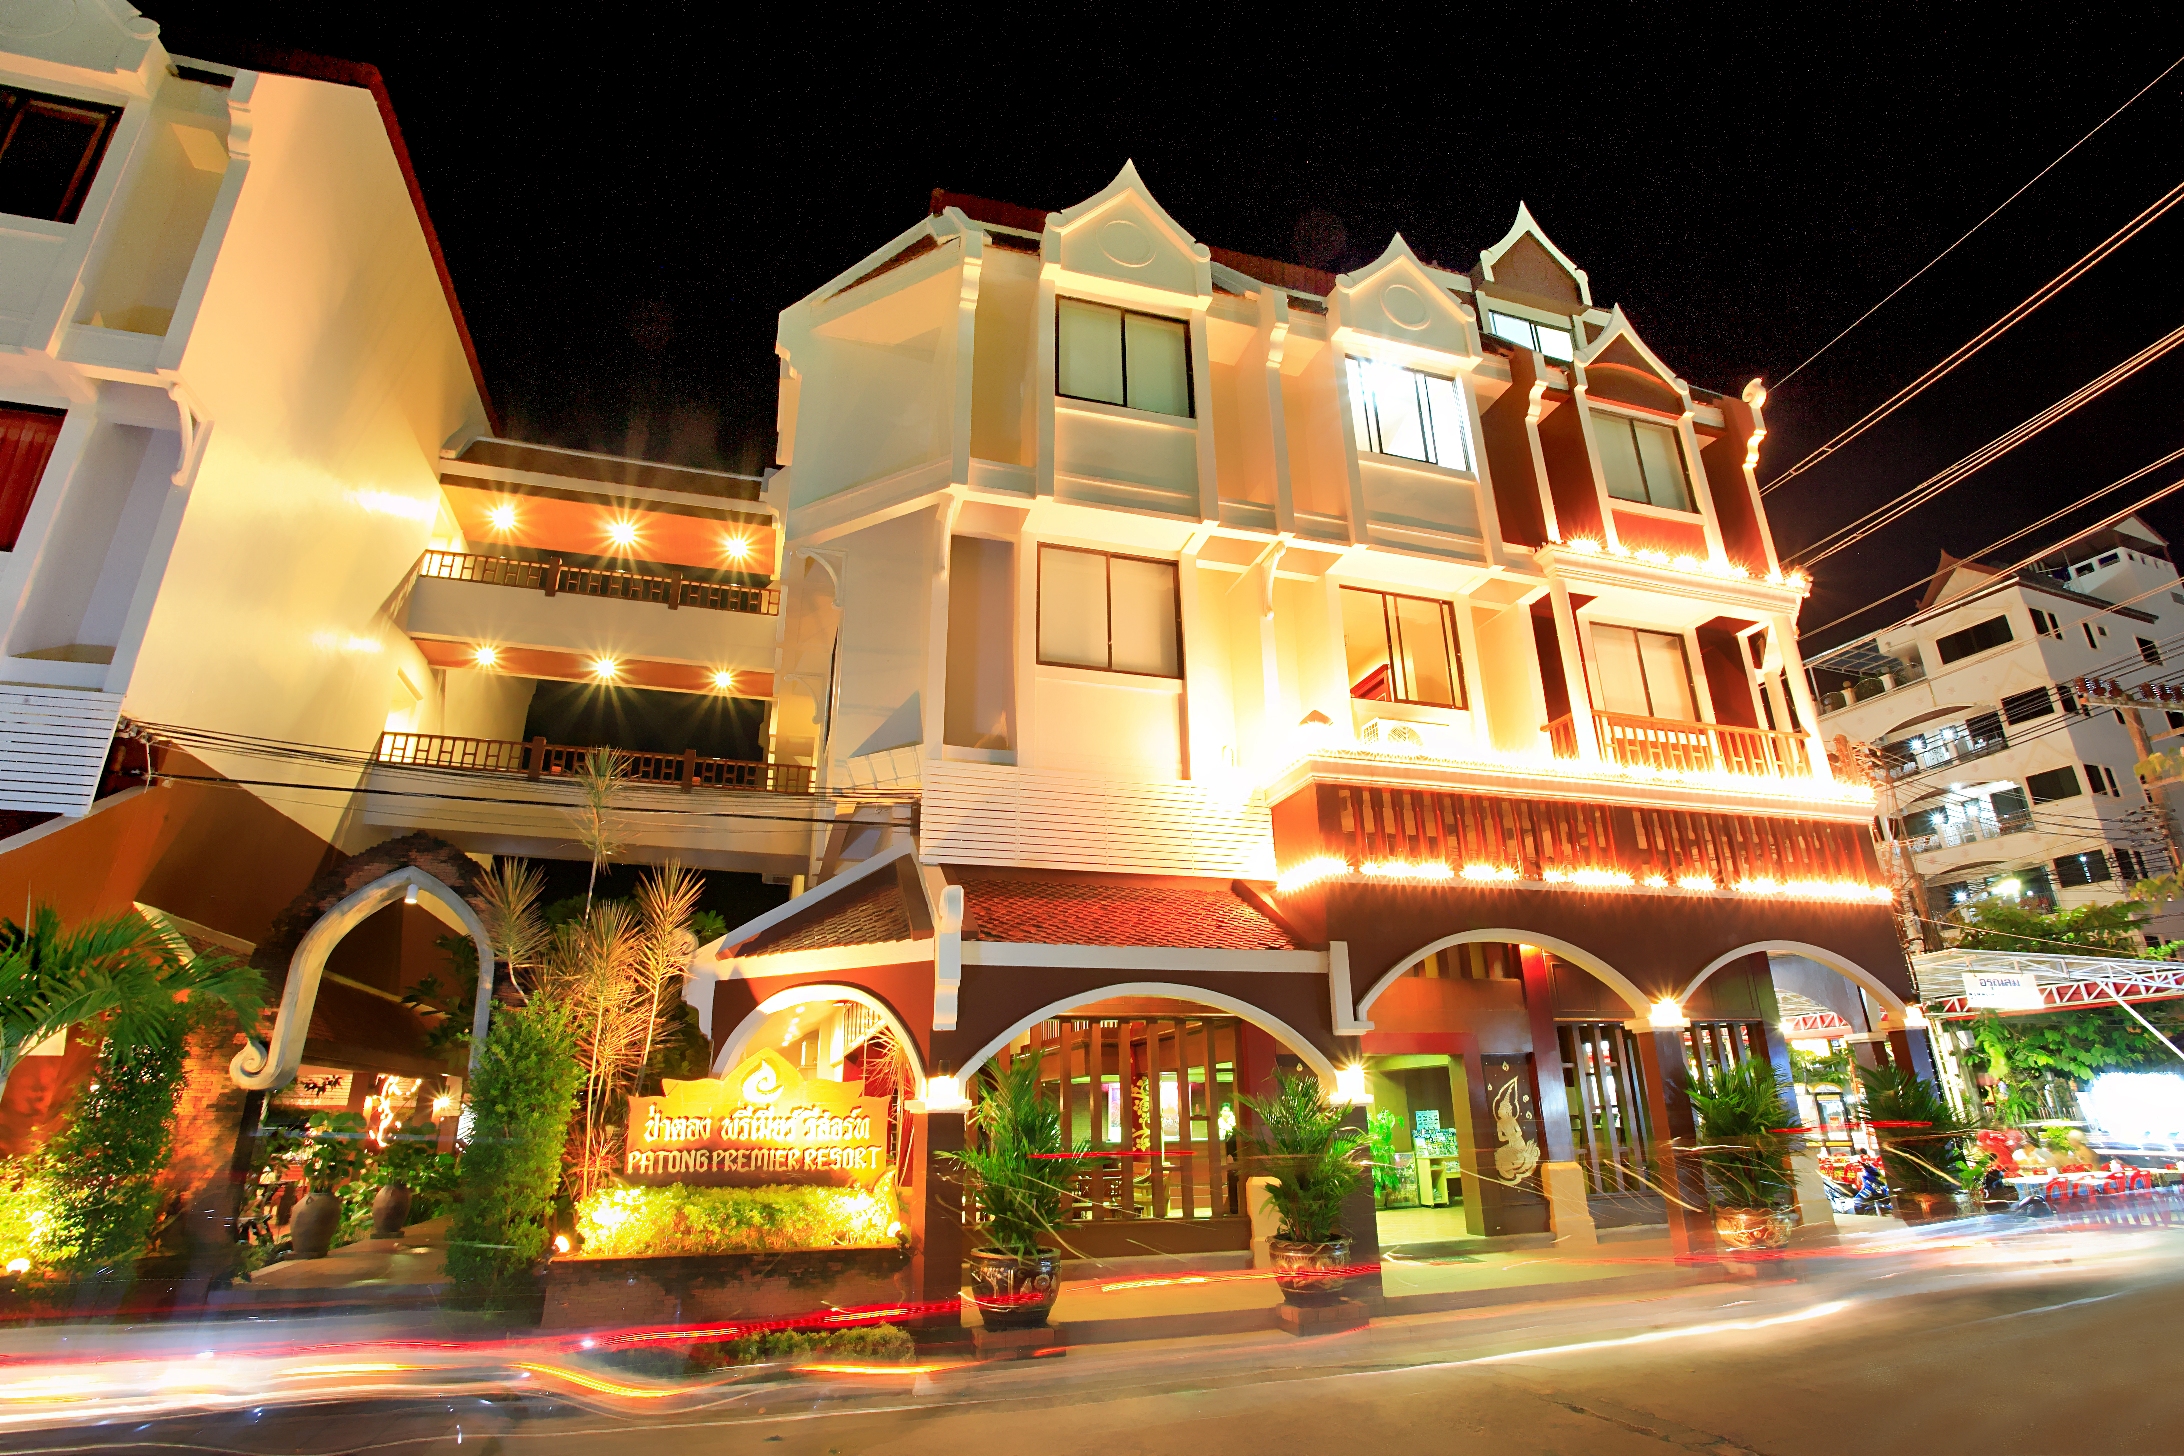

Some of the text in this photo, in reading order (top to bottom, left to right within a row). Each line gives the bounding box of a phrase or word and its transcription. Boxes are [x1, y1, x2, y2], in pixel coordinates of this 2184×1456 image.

[643, 1104, 712, 1142] ป่าตอง
[802, 1104, 871, 1142] รีสอร์ท
[626, 1145, 883, 1175] PATONG PREMIER RESORT
